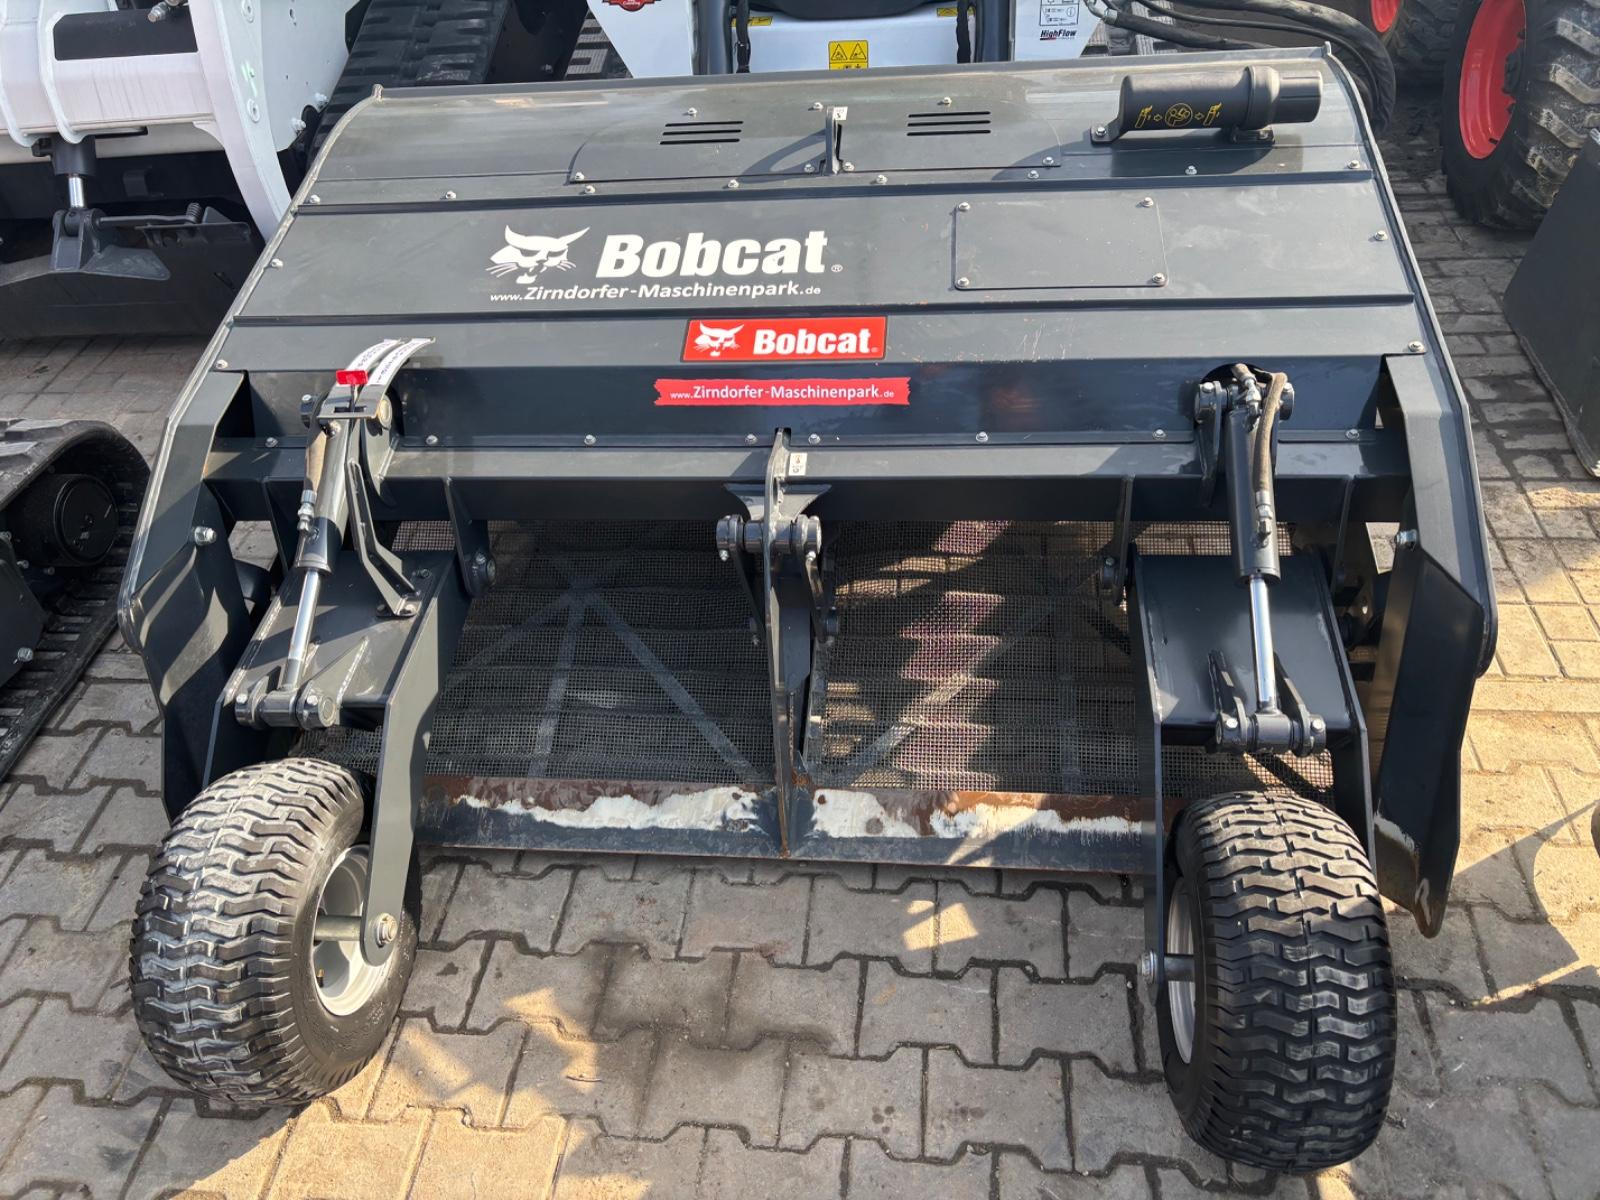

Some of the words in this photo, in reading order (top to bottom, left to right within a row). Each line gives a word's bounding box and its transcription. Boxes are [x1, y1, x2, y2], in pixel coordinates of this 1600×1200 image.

[595, 230, 828, 278] Bobcat
[490, 280, 821, 301] www.Zirndorfer-Maschinenpark.de
[752, 328, 871, 355] Bobcat
[670, 385, 894, 400] www.Zirndorfer-Maschinenpark.de
